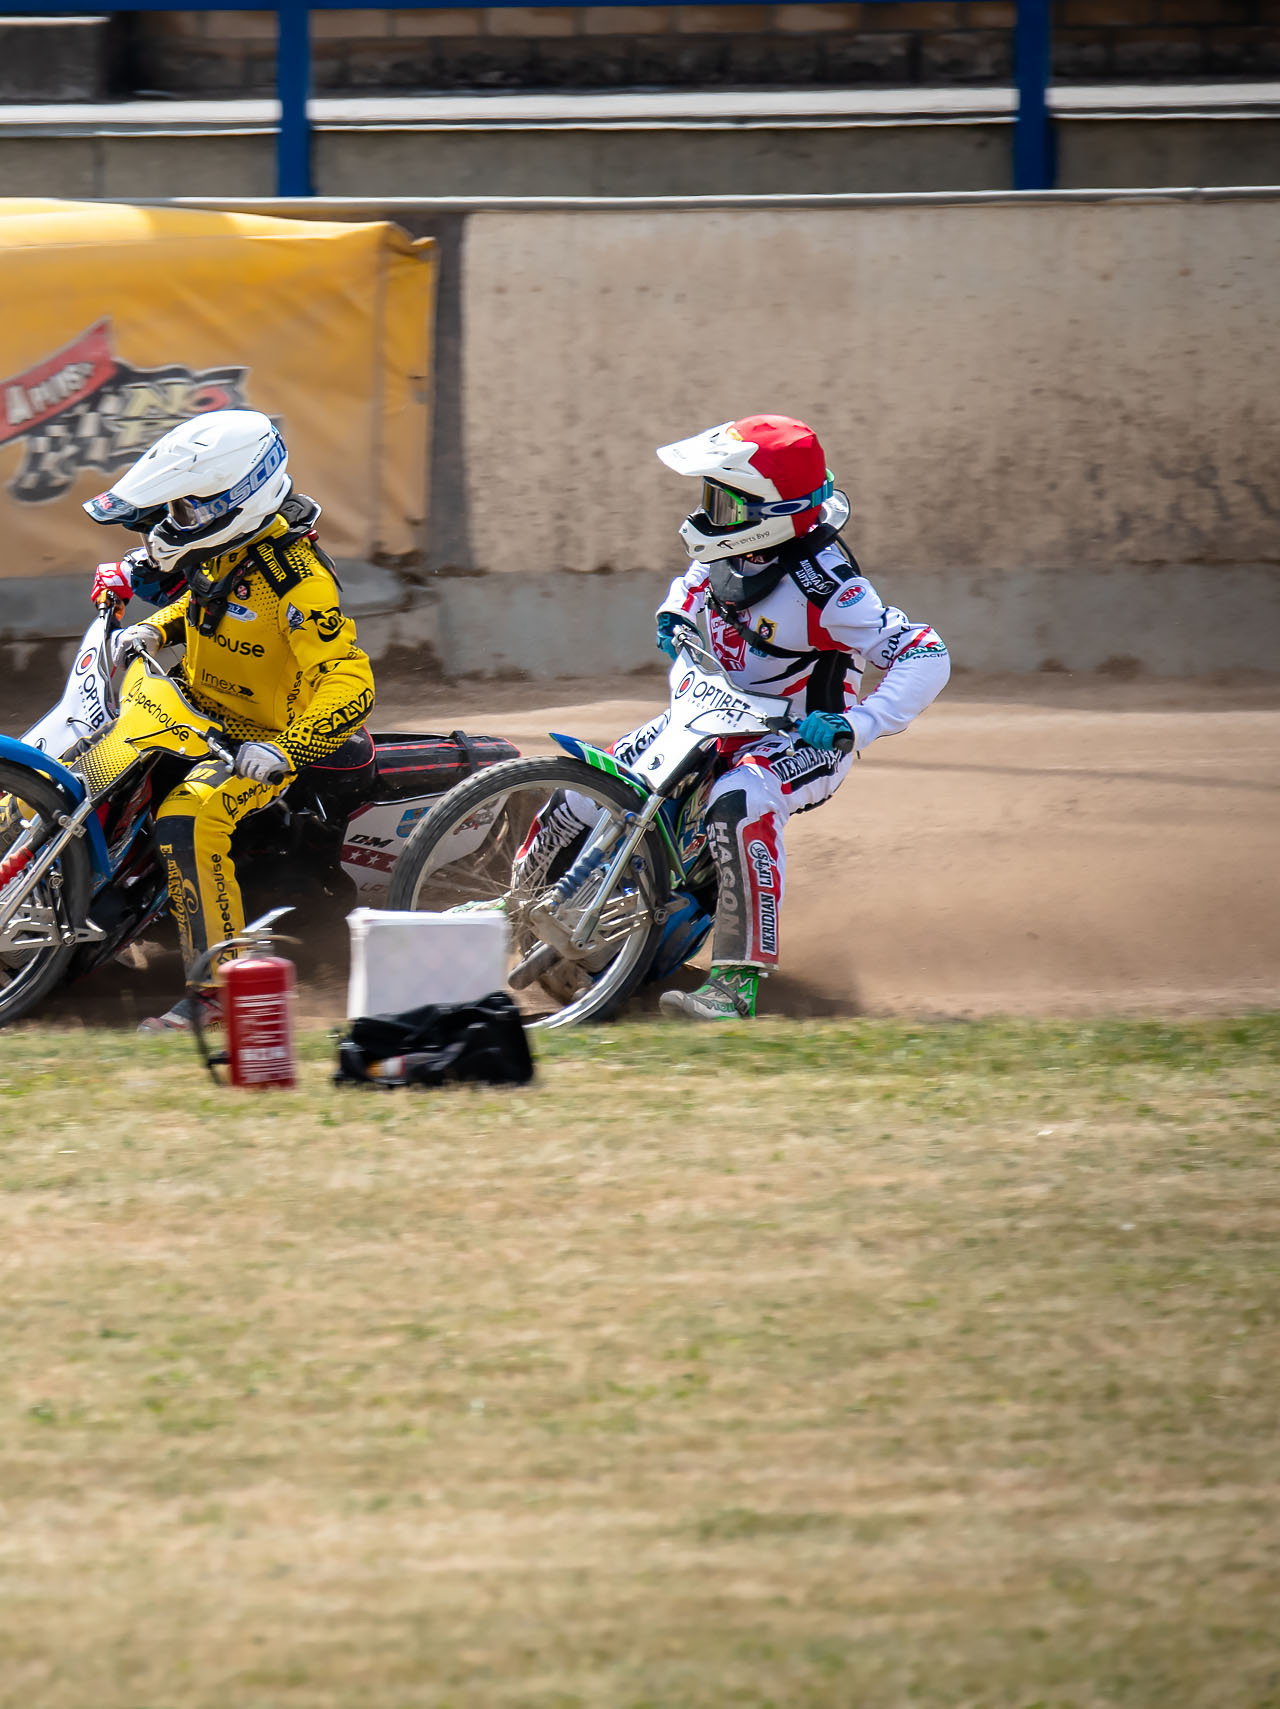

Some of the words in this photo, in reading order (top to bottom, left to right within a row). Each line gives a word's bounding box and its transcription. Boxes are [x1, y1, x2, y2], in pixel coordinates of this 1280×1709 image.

[83, 674, 106, 732] OPTIB
[202, 668, 237, 692] Imex
[693, 681, 751, 722] OPTIBET
[136, 691, 190, 742] spechouse
[714, 821, 740, 936] HAGON
[760, 851, 772, 887] LIFTS
[762, 894, 776, 952] MERIDIAN
